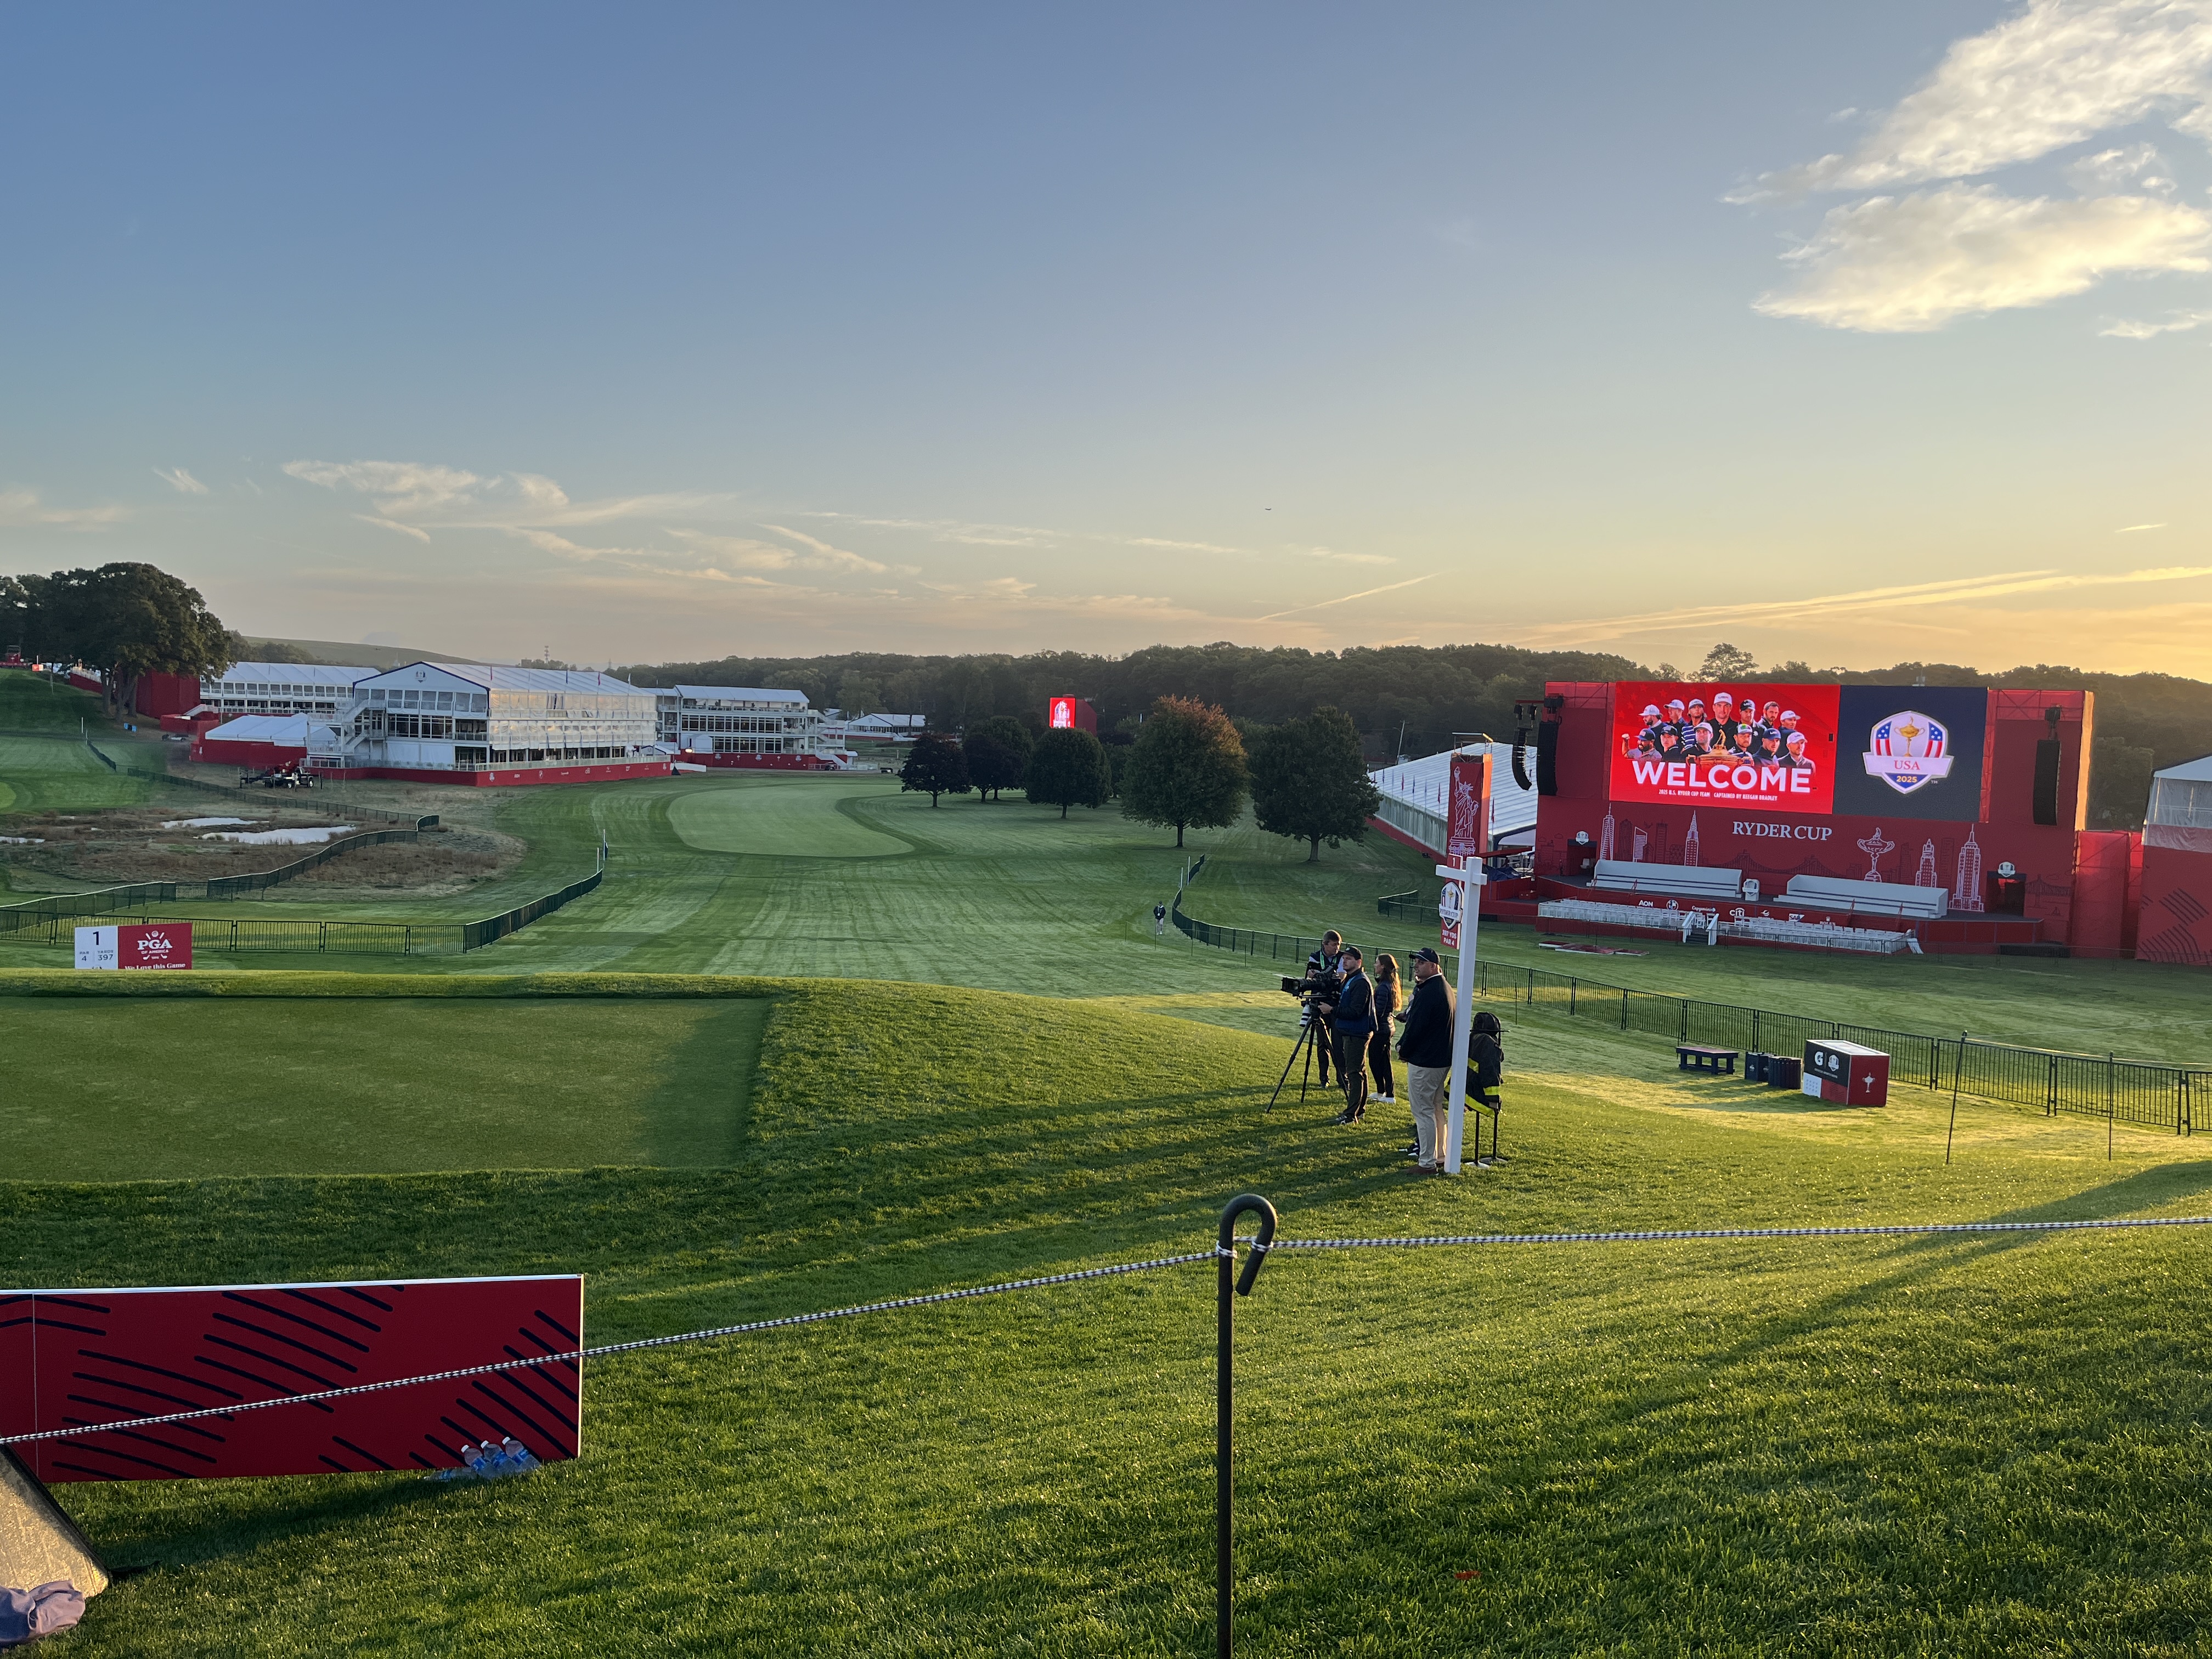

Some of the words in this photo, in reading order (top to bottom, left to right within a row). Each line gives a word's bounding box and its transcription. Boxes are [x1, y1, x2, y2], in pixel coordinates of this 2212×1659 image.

[1894, 760, 1920, 770] USA
[1632, 760, 1811, 793] WELCOME
[1733, 821, 1792, 838] RYDER
[1794, 826, 1832, 840] CUP
[1452, 857, 1455, 867] 1
[93, 931, 99, 945] 1
[1443, 937, 1452, 945] PAR
[137, 939, 173, 950] PGA
